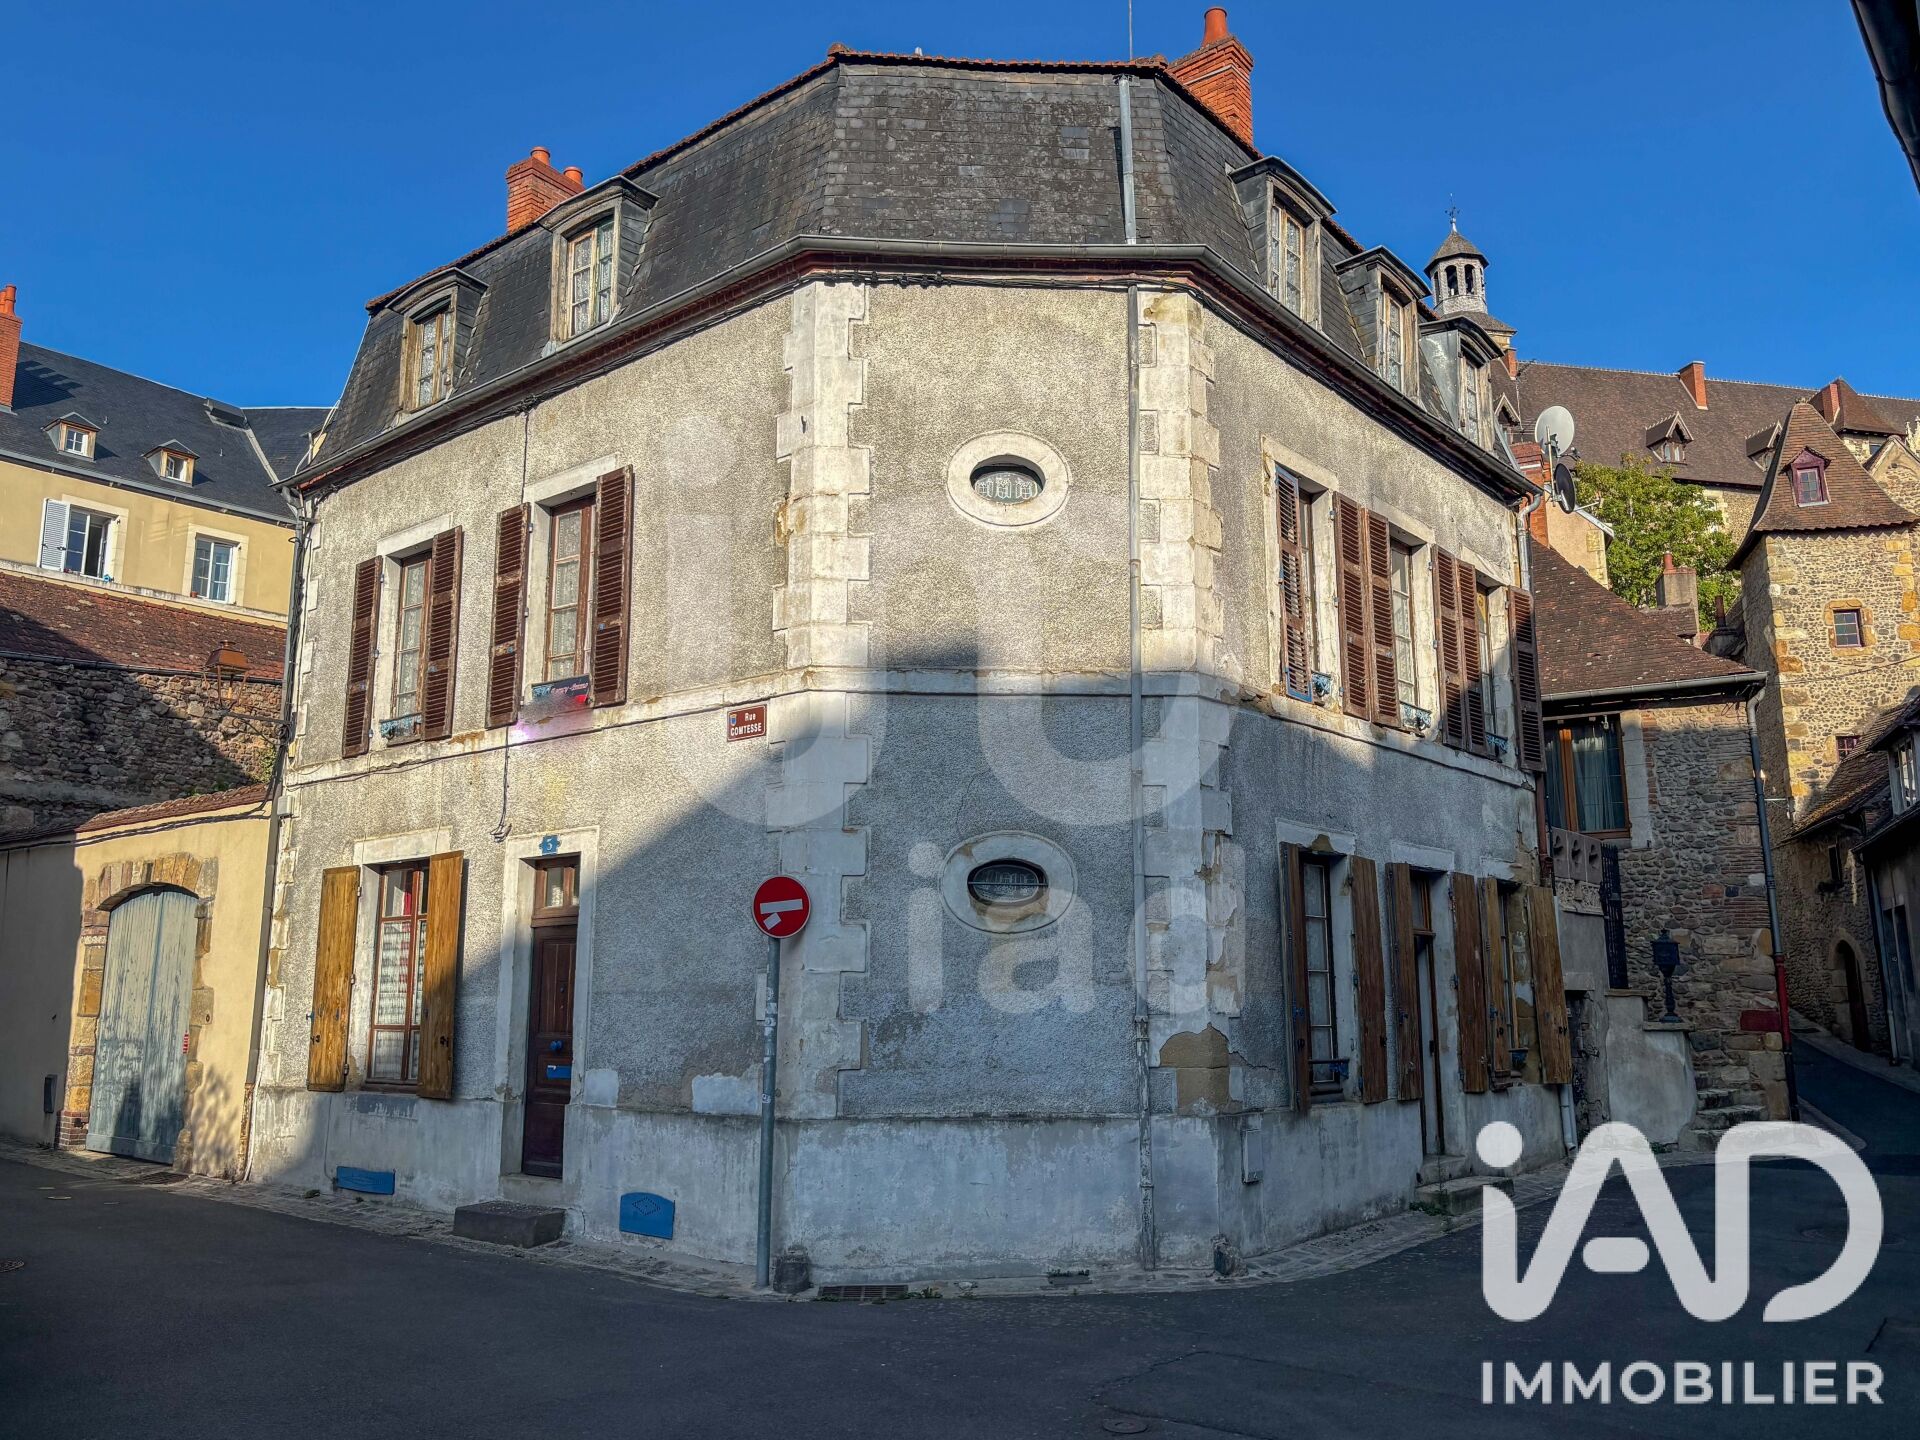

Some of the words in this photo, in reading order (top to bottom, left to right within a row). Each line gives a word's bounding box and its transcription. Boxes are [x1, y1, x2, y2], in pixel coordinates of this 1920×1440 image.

[744, 712, 756, 722] Rue
[730, 723, 762, 736] COMTESSE
[546, 838, 553, 851] 5
